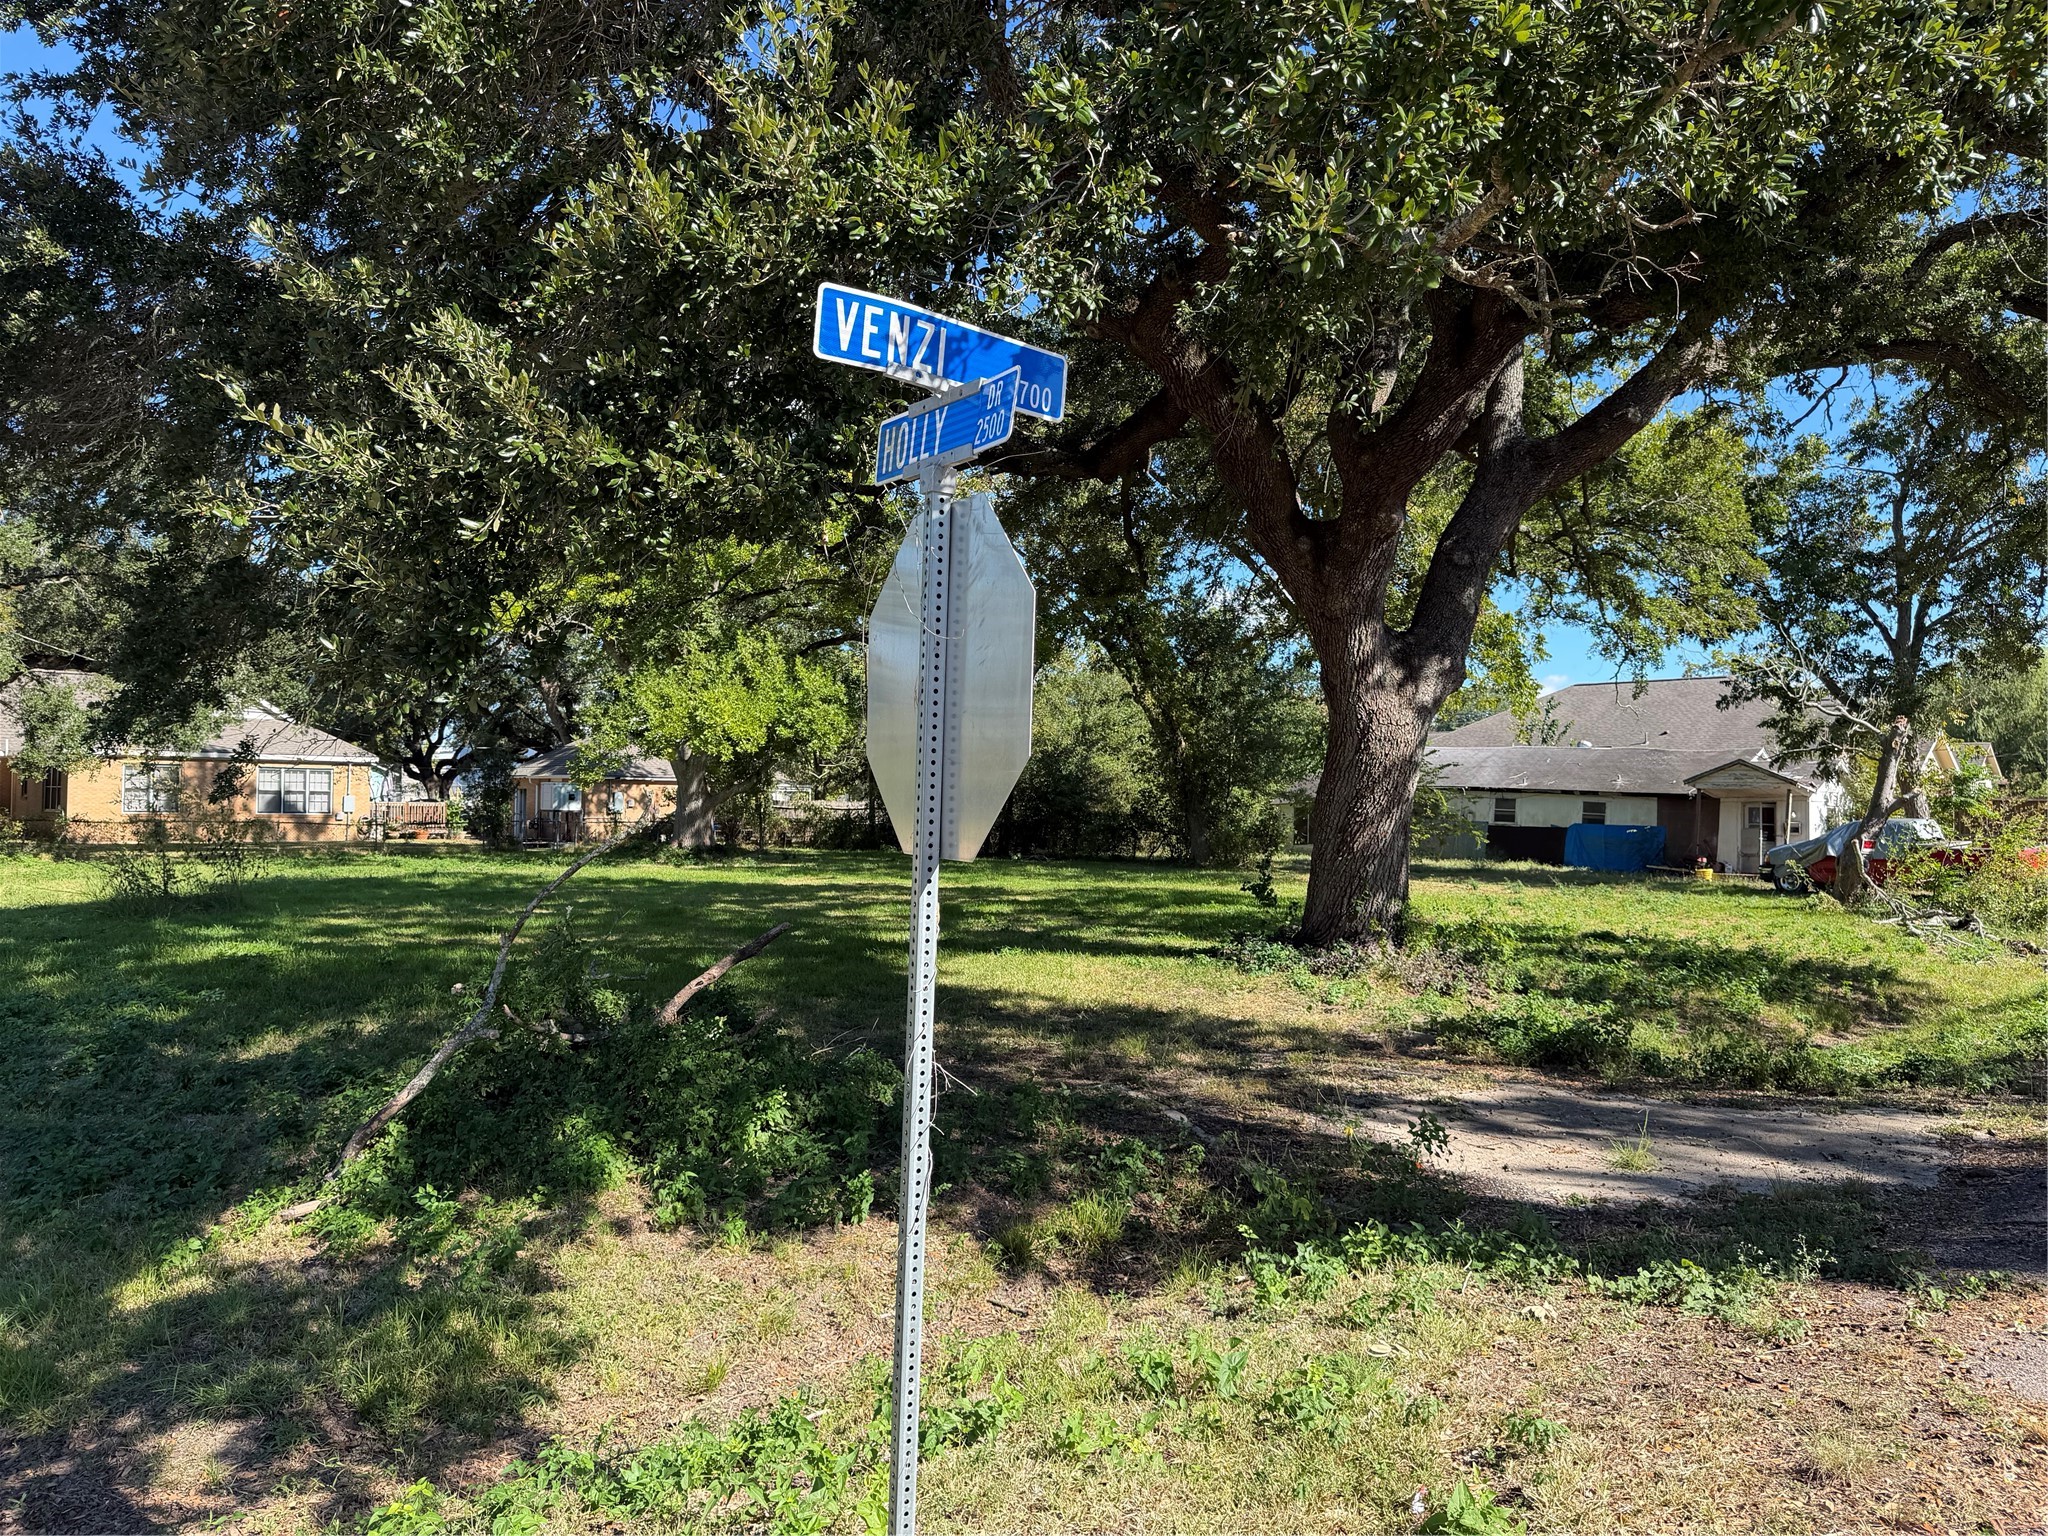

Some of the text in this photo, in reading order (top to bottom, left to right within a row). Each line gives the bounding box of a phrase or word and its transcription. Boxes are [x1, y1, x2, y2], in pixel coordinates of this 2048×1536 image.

[836, 298, 946, 377] VENZI
[882, 380, 1004, 474] HOLLY DR
[973, 409, 1005, 446] 2500
